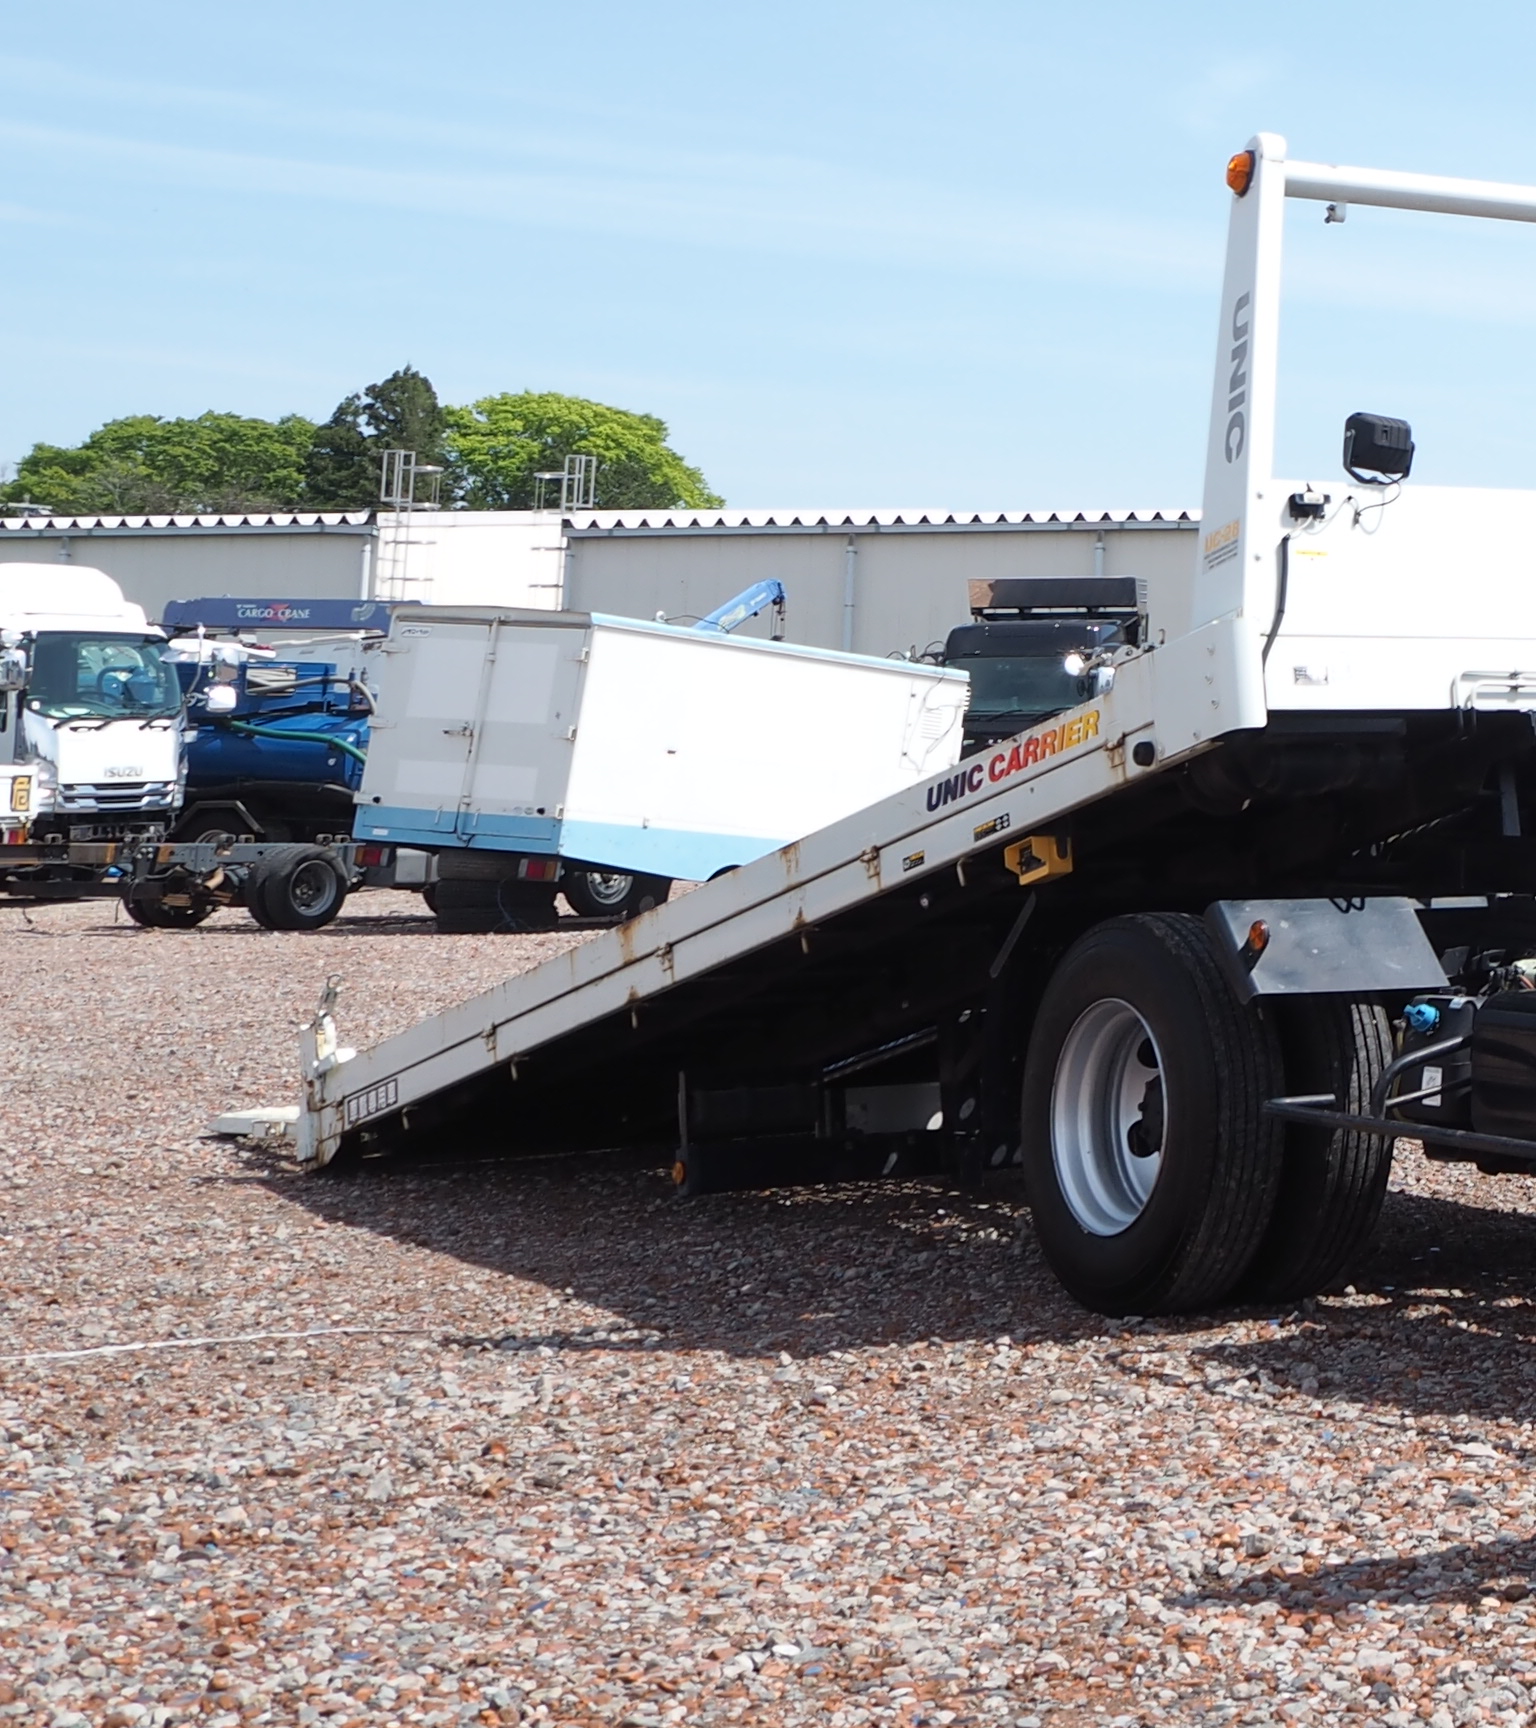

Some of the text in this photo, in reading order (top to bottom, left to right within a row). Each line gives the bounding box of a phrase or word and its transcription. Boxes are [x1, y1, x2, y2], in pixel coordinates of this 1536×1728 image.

[1225, 291, 1250, 464] UNIC
[236, 607, 310, 622] CARGO CRANE
[103, 765, 144, 779] ISUZU
[926, 709, 1101, 813] UNIC CARRIER
